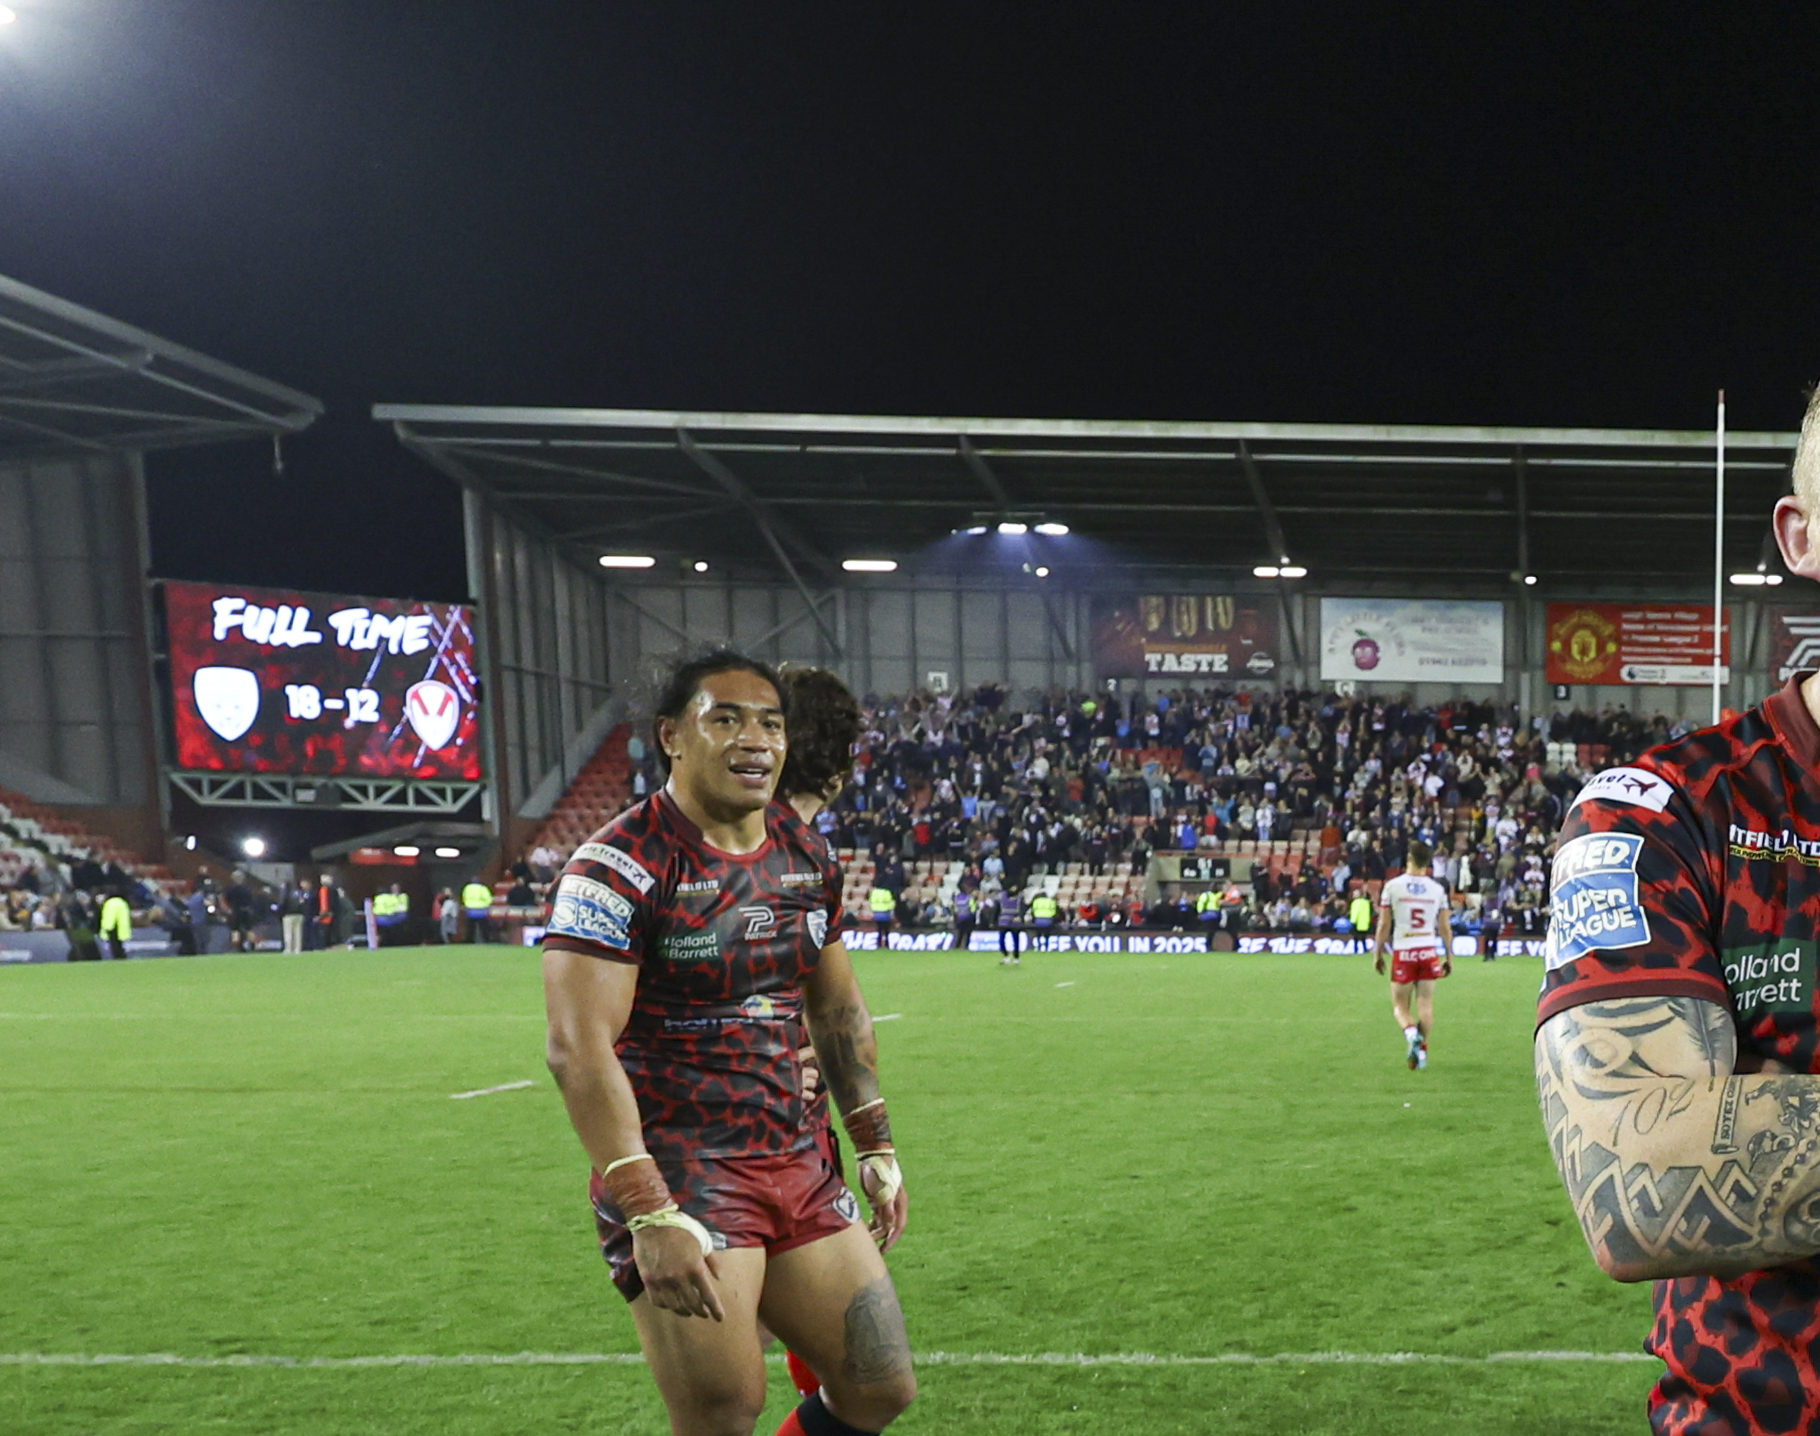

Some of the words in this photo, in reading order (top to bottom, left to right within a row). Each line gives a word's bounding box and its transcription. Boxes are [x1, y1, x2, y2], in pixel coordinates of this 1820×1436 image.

[212, 597, 322, 647] FULL
[328, 608, 433, 655] TIME
[1144, 652, 1229, 673] TASTE
[1410, 908, 1425, 929] 5
[1559, 906, 1637, 949] LEAGUE
[669, 946, 719, 960] Barrett
[1128, 936, 1150, 953] IN
[1154, 936, 1208, 953] 2025
